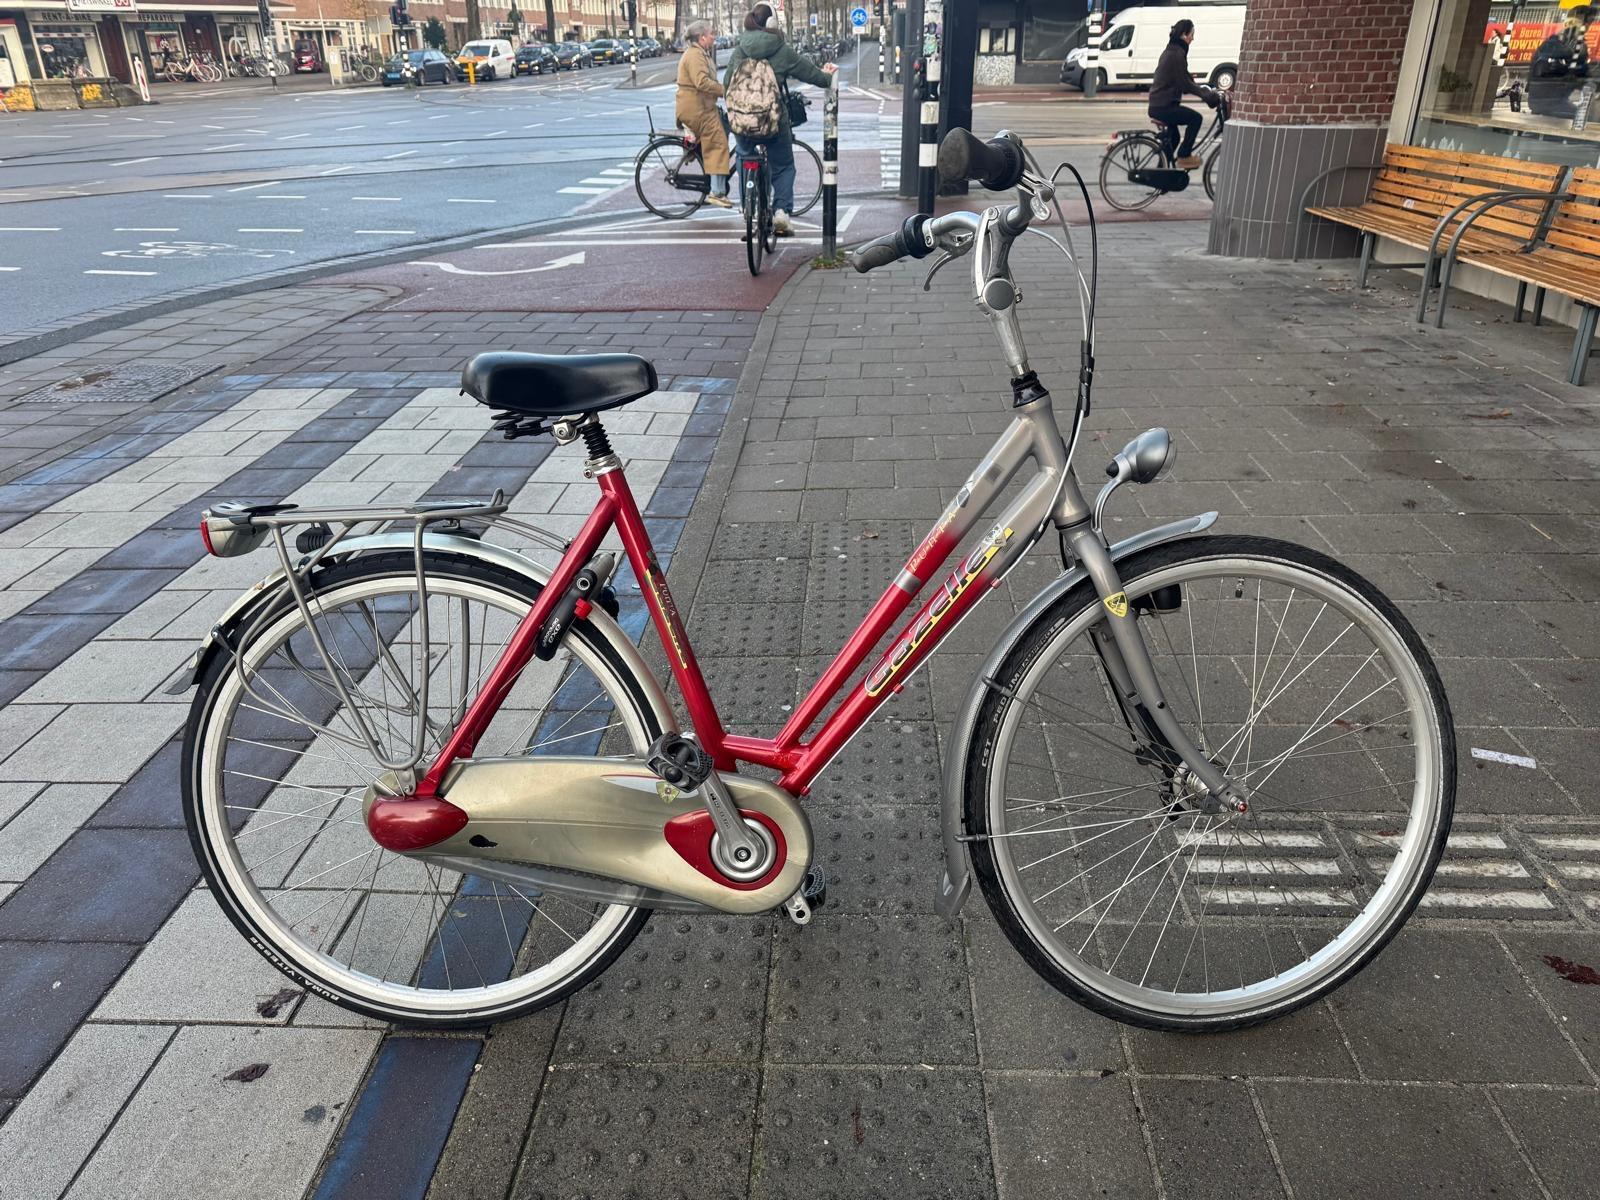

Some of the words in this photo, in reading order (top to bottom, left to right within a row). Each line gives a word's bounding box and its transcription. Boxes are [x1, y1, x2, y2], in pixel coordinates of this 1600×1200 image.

[137, 13, 175, 22] REPARATIE
[864, 545, 989, 694] Gazelle
[981, 738, 992, 768] CST
[249, 936, 296, 977] VITESSE
